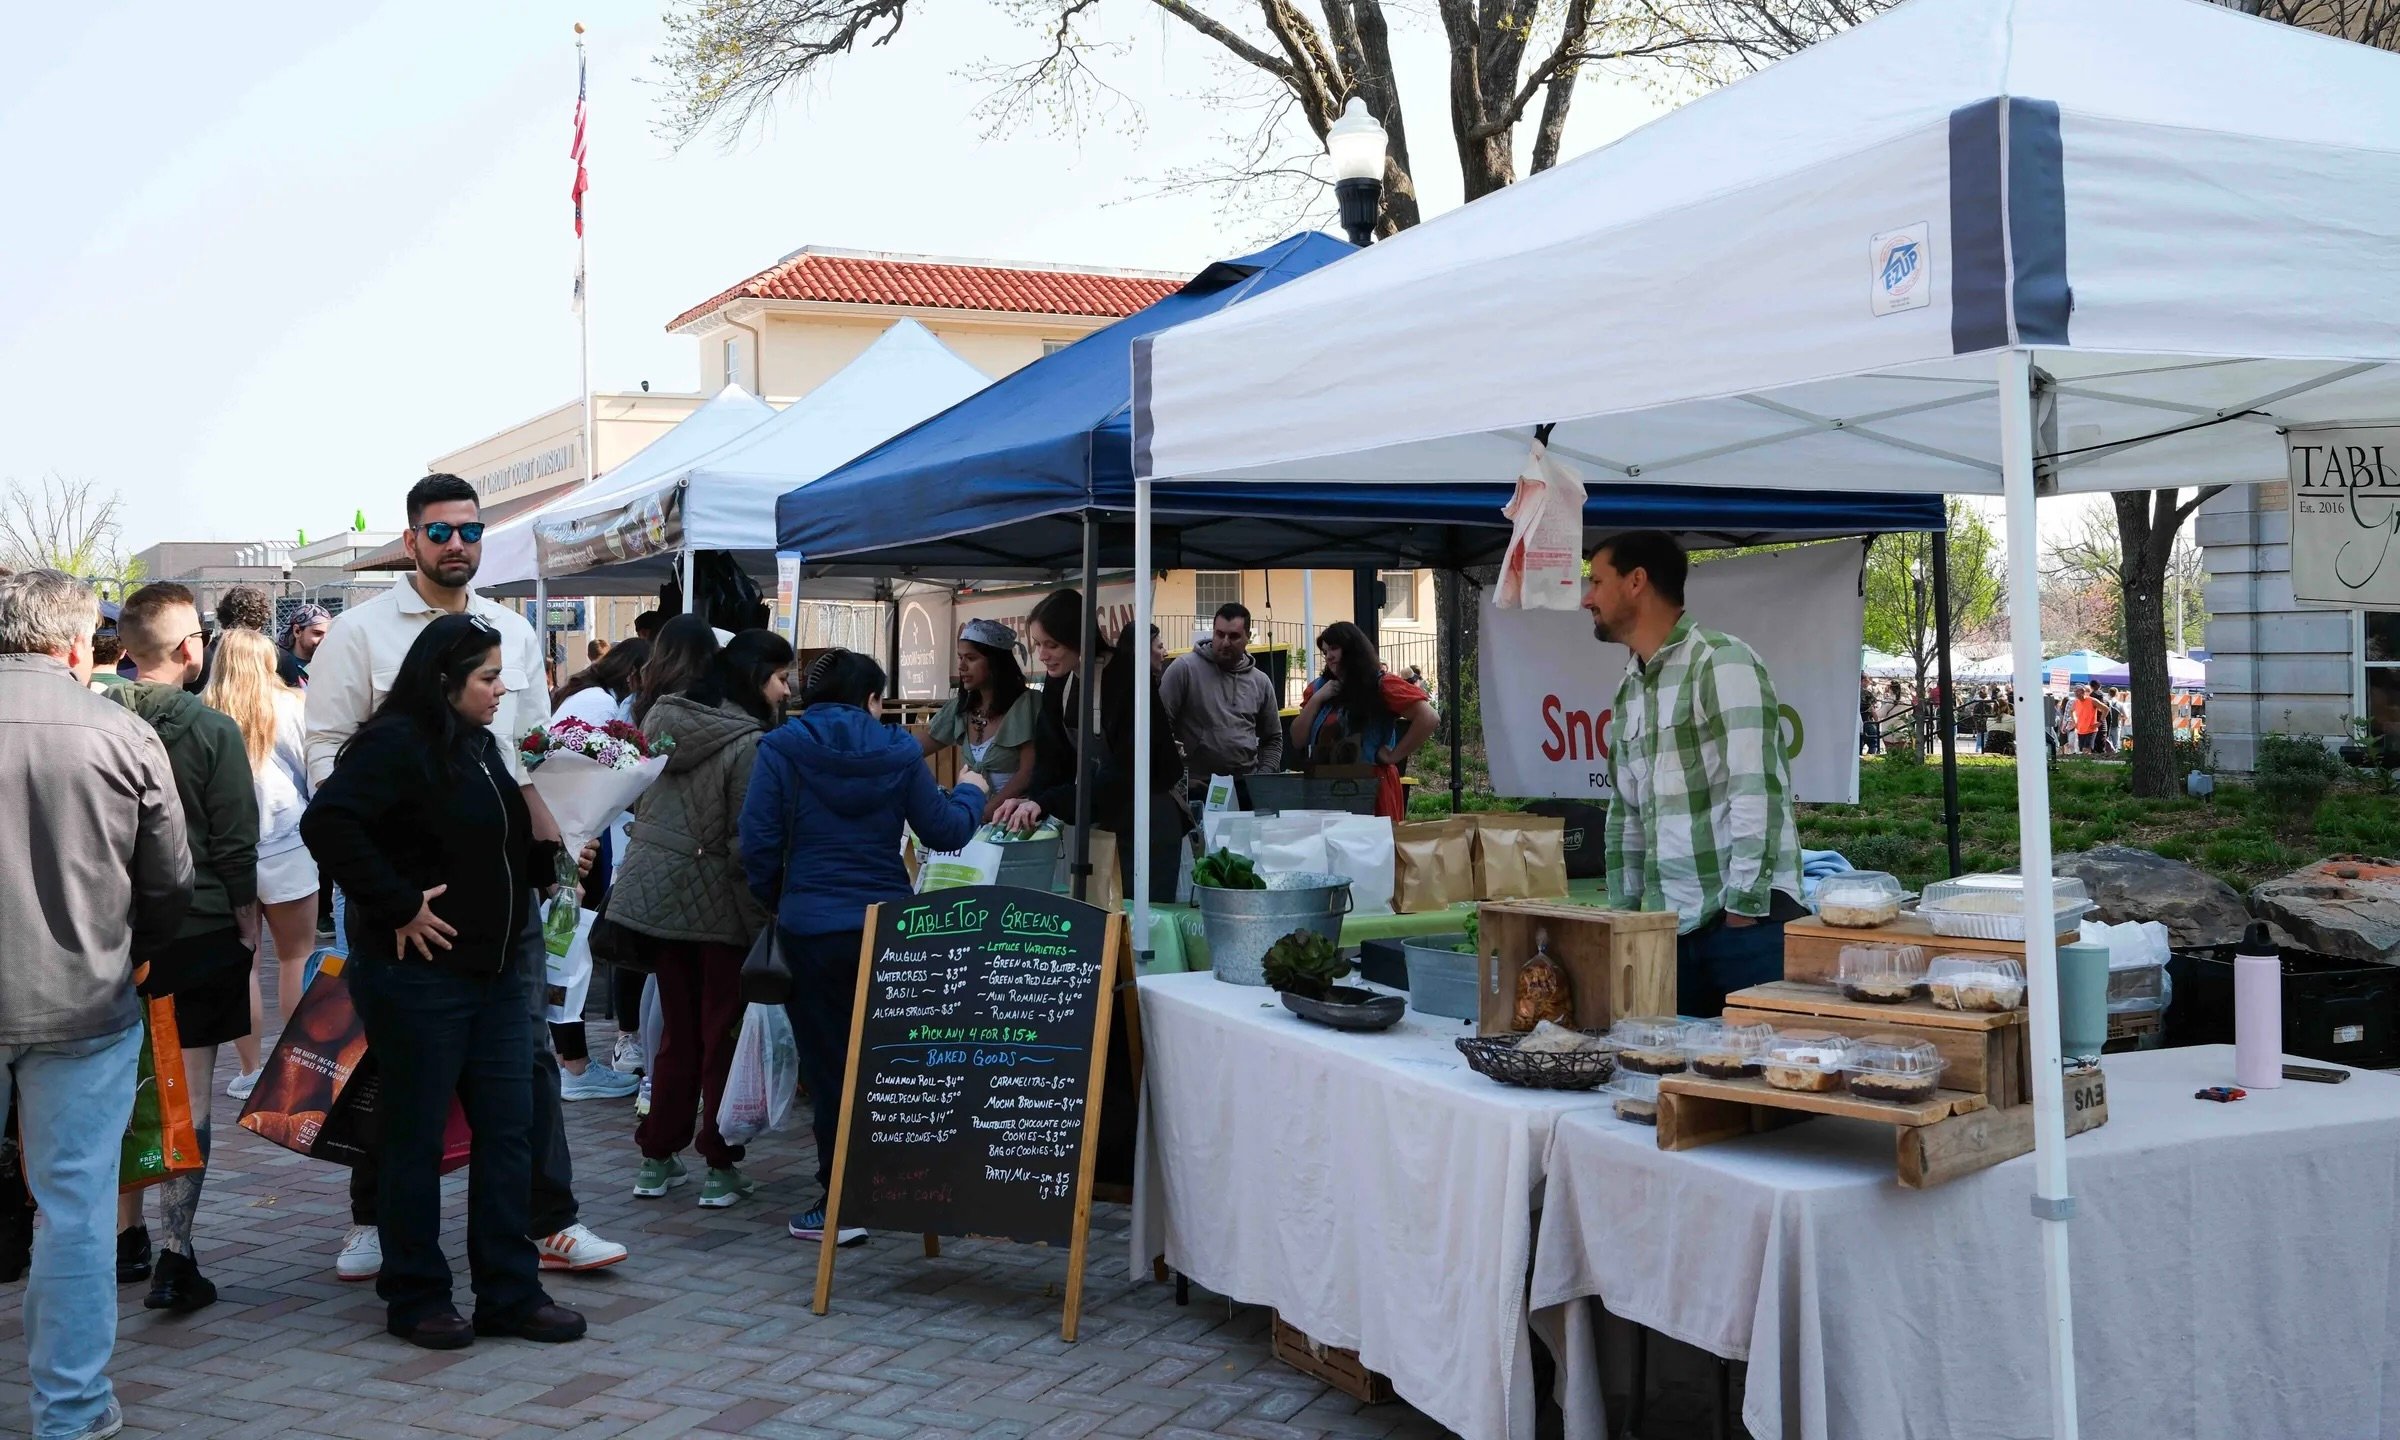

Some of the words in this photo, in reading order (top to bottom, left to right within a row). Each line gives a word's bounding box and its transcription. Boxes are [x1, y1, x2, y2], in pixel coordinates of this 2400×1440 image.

[488, 466, 511, 494] CIRCUIT
[512, 457, 535, 486] COURT
[536, 446, 567, 479] DIVISION
[2300, 501, 2315, 513] Est.
[2318, 502, 2345, 513] 2016
[1001, 902, 1059, 933] GREENS
[880, 948, 927, 963] ARUGULA
[987, 942, 1020, 952] LETTUCE
[1024, 942, 1067, 956] VARIETIES
[993, 955, 1021, 969] GREEN
[1022, 961, 1032, 969] OR
[1033, 958, 1050, 971] RED
[1051, 960, 1077, 973] BUTTER
[876, 970, 928, 983] WATERCRESS
[989, 970, 1015, 985] GREEN
[1024, 974, 1040, 986] RED
[1042, 976, 1062, 985] LEAF
[886, 986, 918, 1000] BASIL
[986, 991, 1006, 1001] MINI
[1009, 989, 1048, 1003] ROMAINE
[872, 1007, 904, 1020] ALFALFA
[906, 1006, 935, 1017] SPROUTS
[990, 1005, 1034, 1020] ROMAINE
[921, 1025, 942, 1040] PICK
[945, 1027, 964, 1042] ANY
[970, 1028, 977, 1041] 4
[980, 1028, 999, 1040] FOR
[926, 1049, 967, 1067] BAKED
[973, 1049, 1017, 1067] GOODS
[316, 1066, 328, 1075] PER
[168, 1079, 174, 1087] S
[876, 1072, 917, 1085] CINNAMON
[918, 1074, 937, 1087] ROLL
[990, 1076, 1046, 1089] CARAMELITAS
[867, 1091, 898, 1104] CARAMEL
[898, 1093, 921, 1104] PECAN
[922, 1092, 937, 1103] ROLL
[984, 1096, 1015, 1109] MOCHA
[1018, 1096, 1055, 1109] BROWNIE
[871, 1111, 887, 1122] PAN
[888, 1113, 898, 1122] OF
[900, 1112, 922, 1124] ROLLS
[1018, 1119, 1059, 1130] CHOCOLATE
[1061, 1119, 1081, 1129] CHIP
[872, 1132, 904, 1143] ORANGE
[905, 1132, 931, 1143] SCONES
[1002, 1131, 1038, 1142] COOKIES
[989, 1144, 1005, 1157] BAG
[1006, 1146, 1016, 1156] OF
[1017, 1145, 1049, 1157] COOKIES
[140, 1155, 162, 1163] FRESH
[985, 1165, 1012, 1184] PARTY
[1010, 1168, 1031, 1181] MIX
[1056, 1172, 1070, 1185] $5
